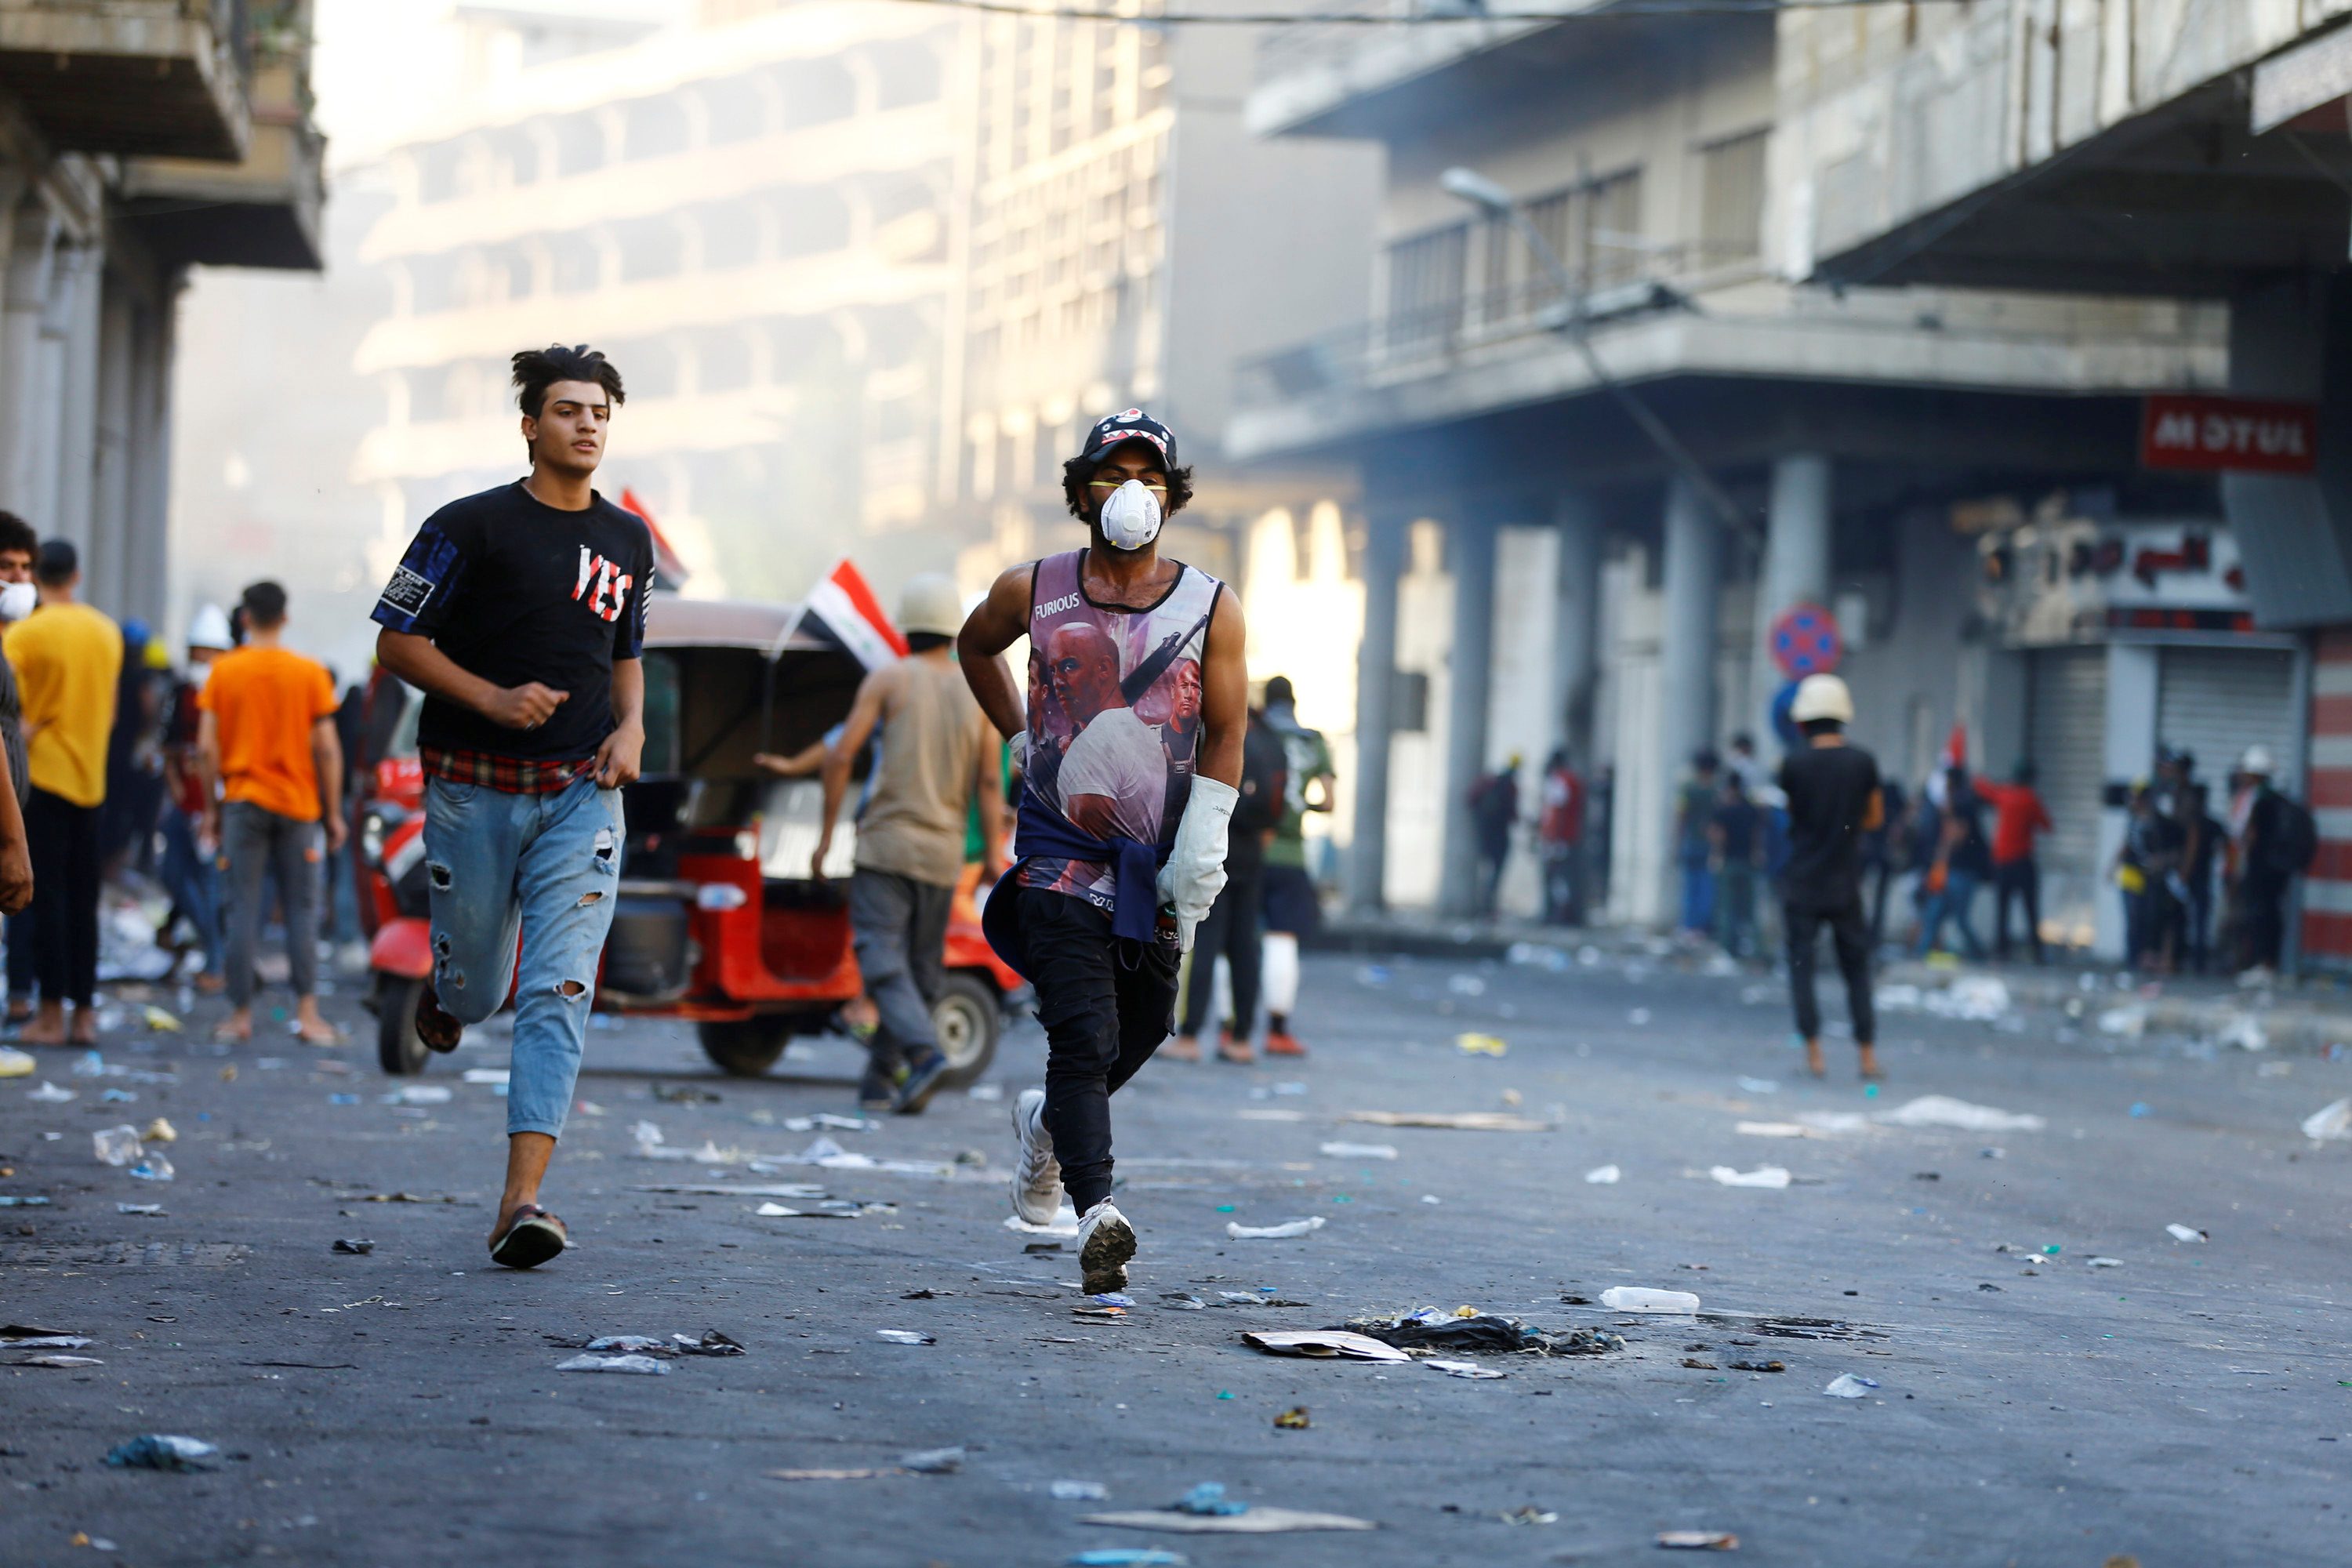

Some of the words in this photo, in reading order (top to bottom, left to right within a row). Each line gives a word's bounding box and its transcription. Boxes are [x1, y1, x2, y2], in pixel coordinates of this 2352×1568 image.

[2154, 413, 2305, 456] MOTUL
[570, 544, 633, 622] YES
[1034, 592, 1080, 621] FURIOUS
